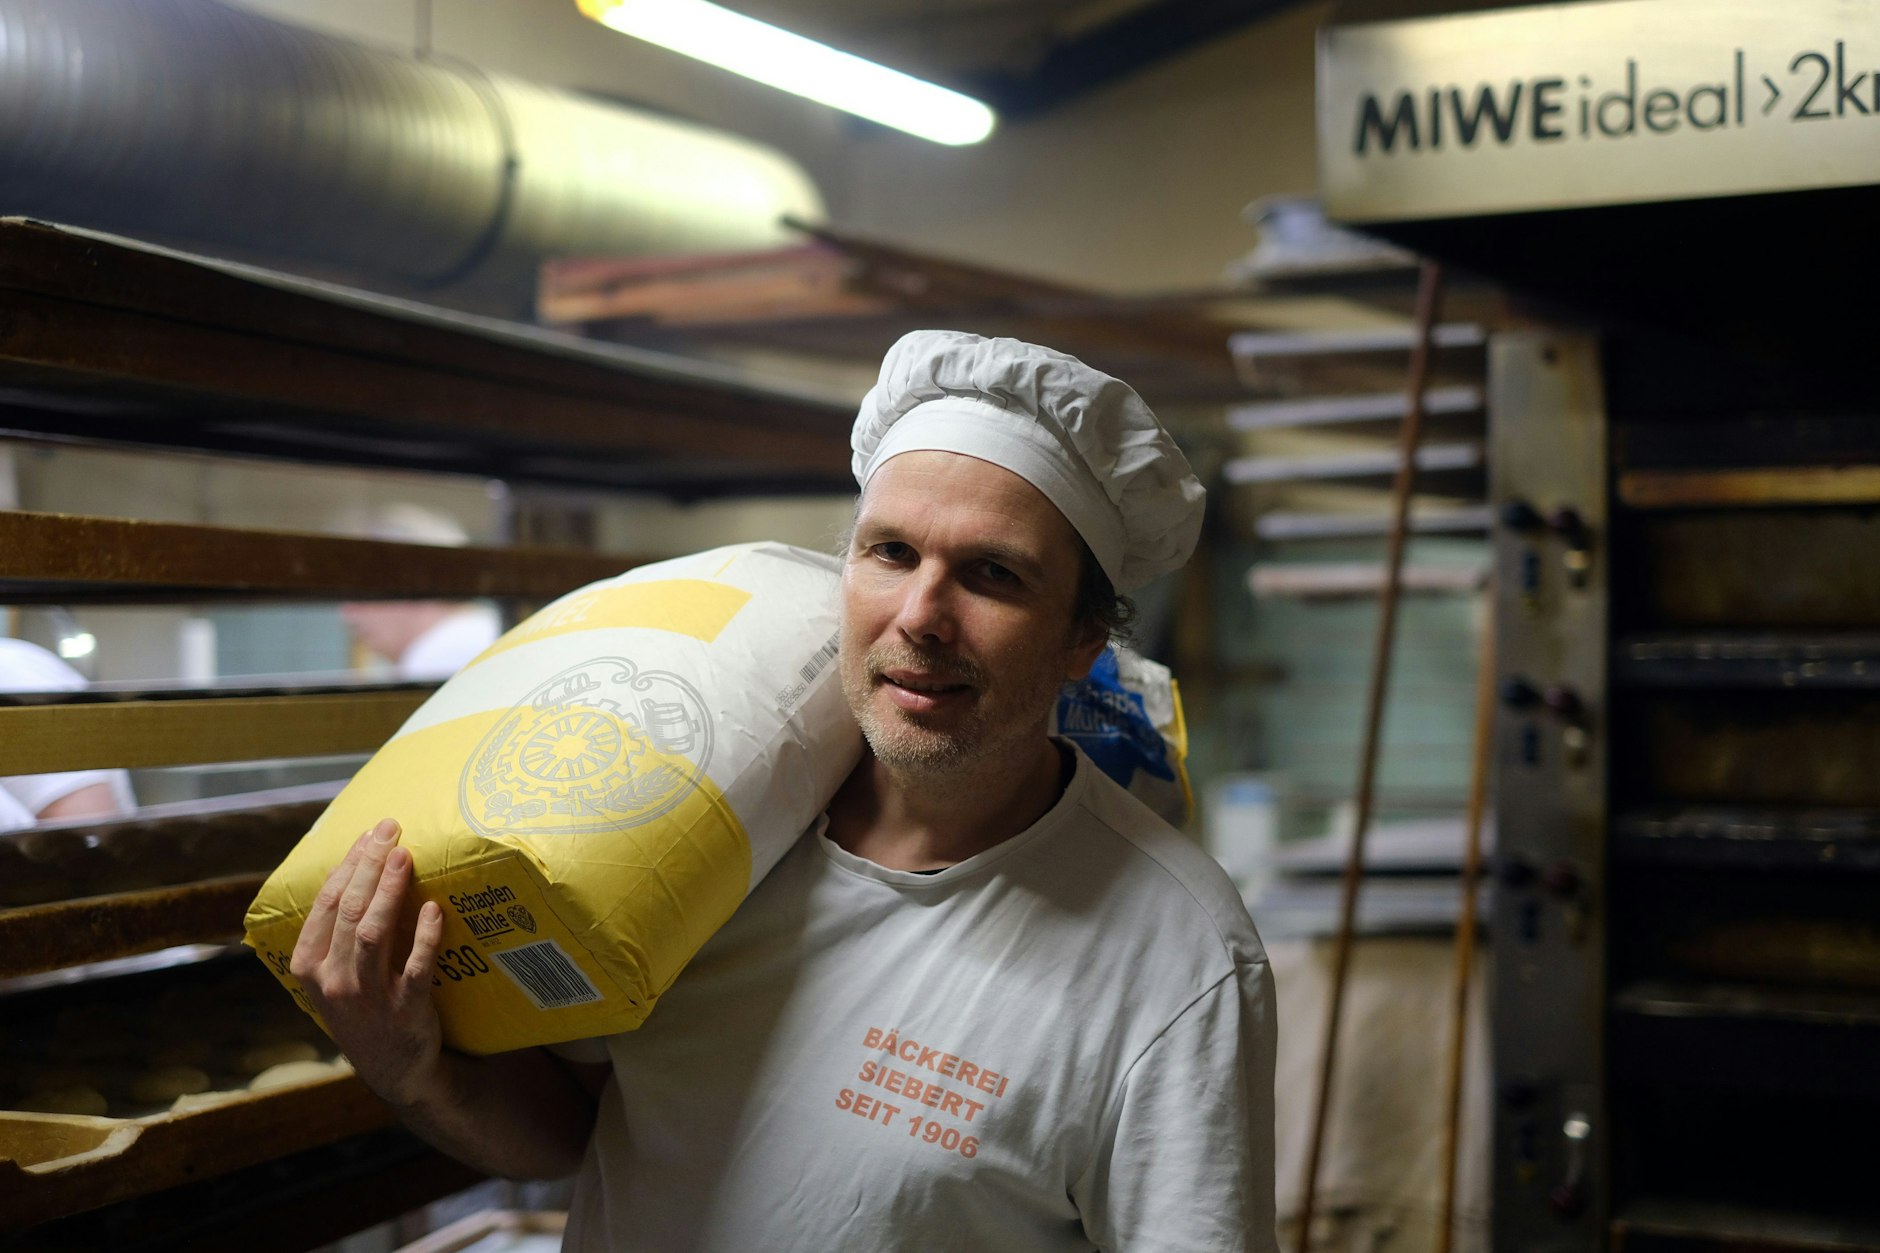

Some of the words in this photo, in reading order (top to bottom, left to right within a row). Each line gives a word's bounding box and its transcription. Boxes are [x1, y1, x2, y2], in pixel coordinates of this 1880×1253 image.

[1356, 79, 1566, 155] MIWE
[1578, 47, 1744, 138] ideal
[449, 885, 517, 913] Schapfen
[463, 910, 510, 936] Mühle
[437, 945, 490, 982] 630
[858, 1060, 985, 1122] SIEBERT
[863, 1026, 1010, 1099] BÄCKEREI
[835, 1087, 901, 1127] SEIT
[908, 1115, 980, 1159] 1906
